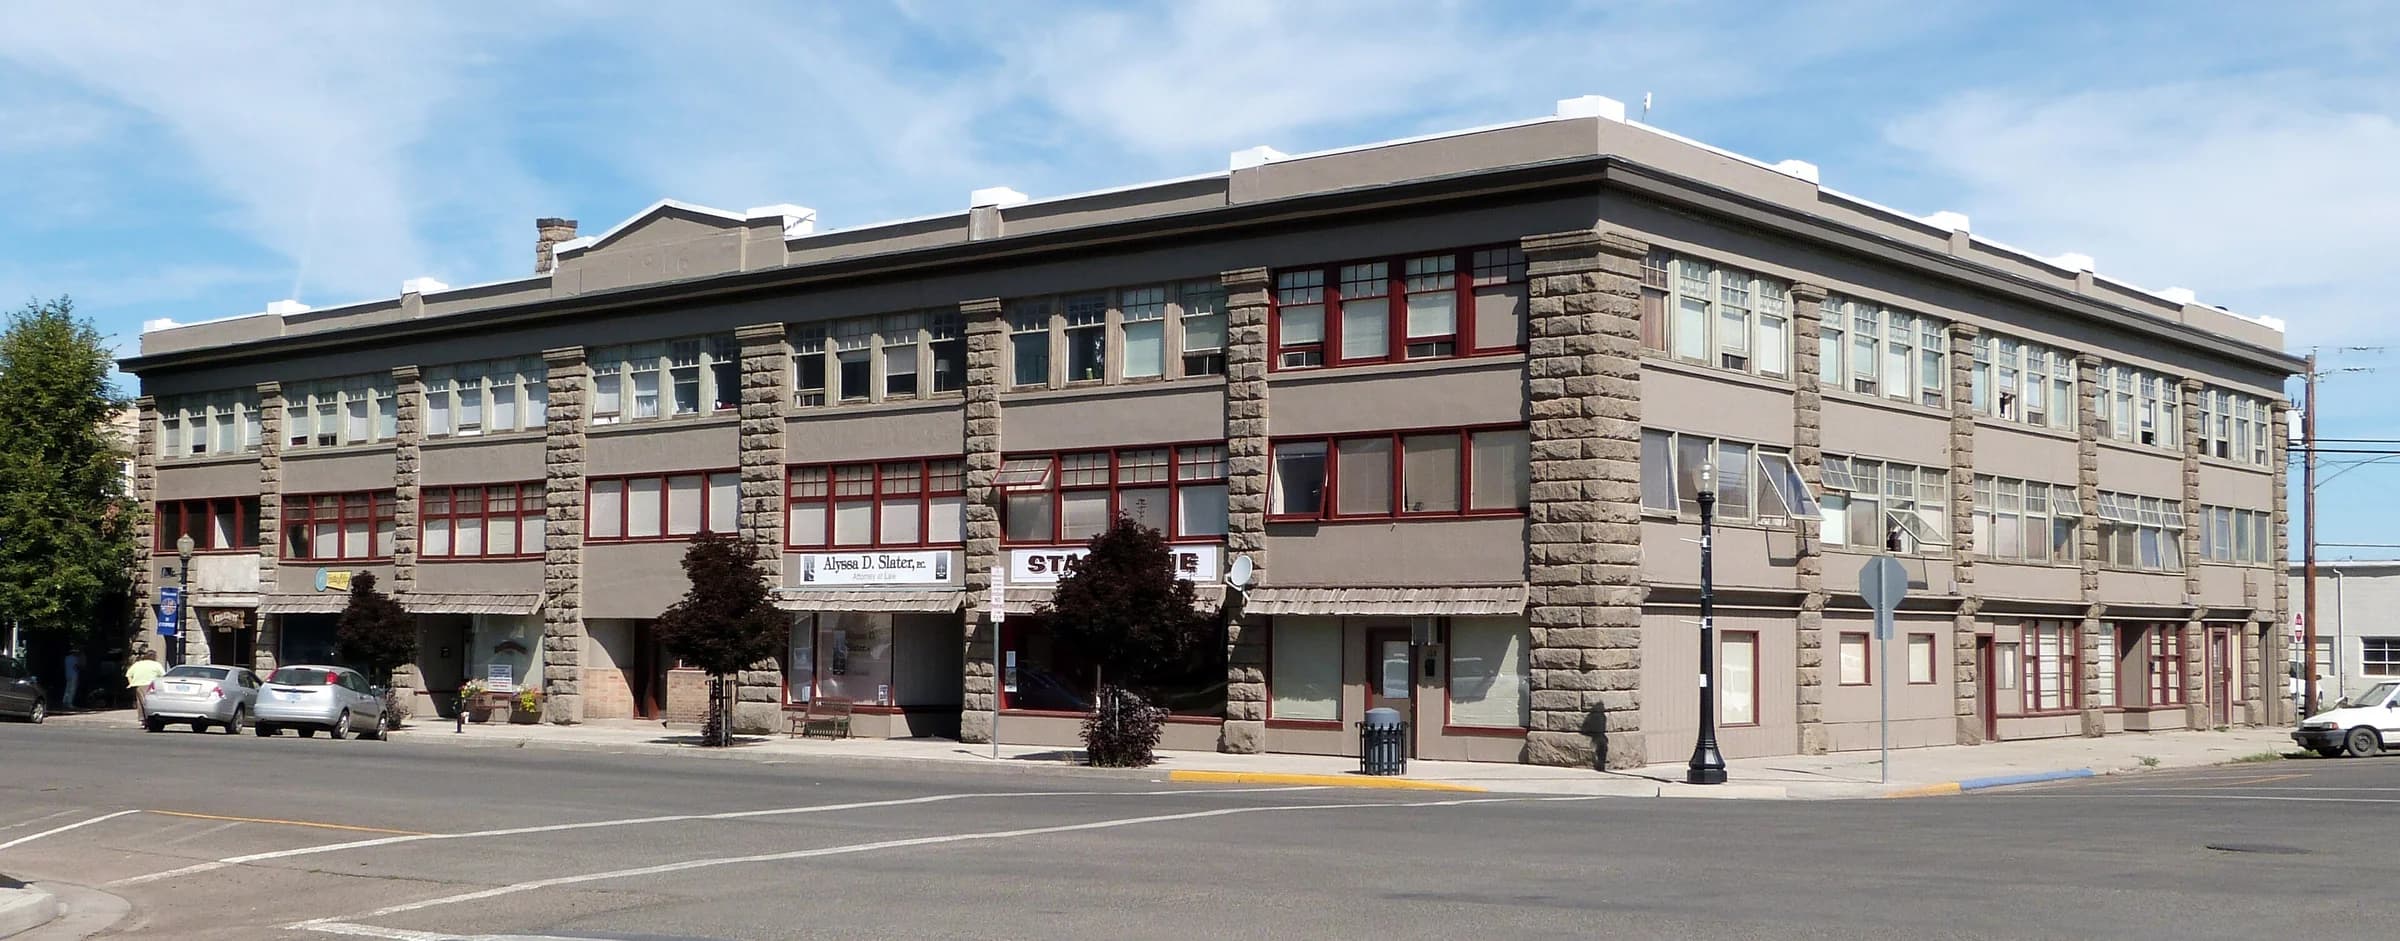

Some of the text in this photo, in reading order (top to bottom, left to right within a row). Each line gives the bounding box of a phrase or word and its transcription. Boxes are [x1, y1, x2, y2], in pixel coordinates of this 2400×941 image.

[823, 556, 859, 574] Alyssa
[862, 555, 875, 569] D.
[878, 554, 915, 572] Slater,
